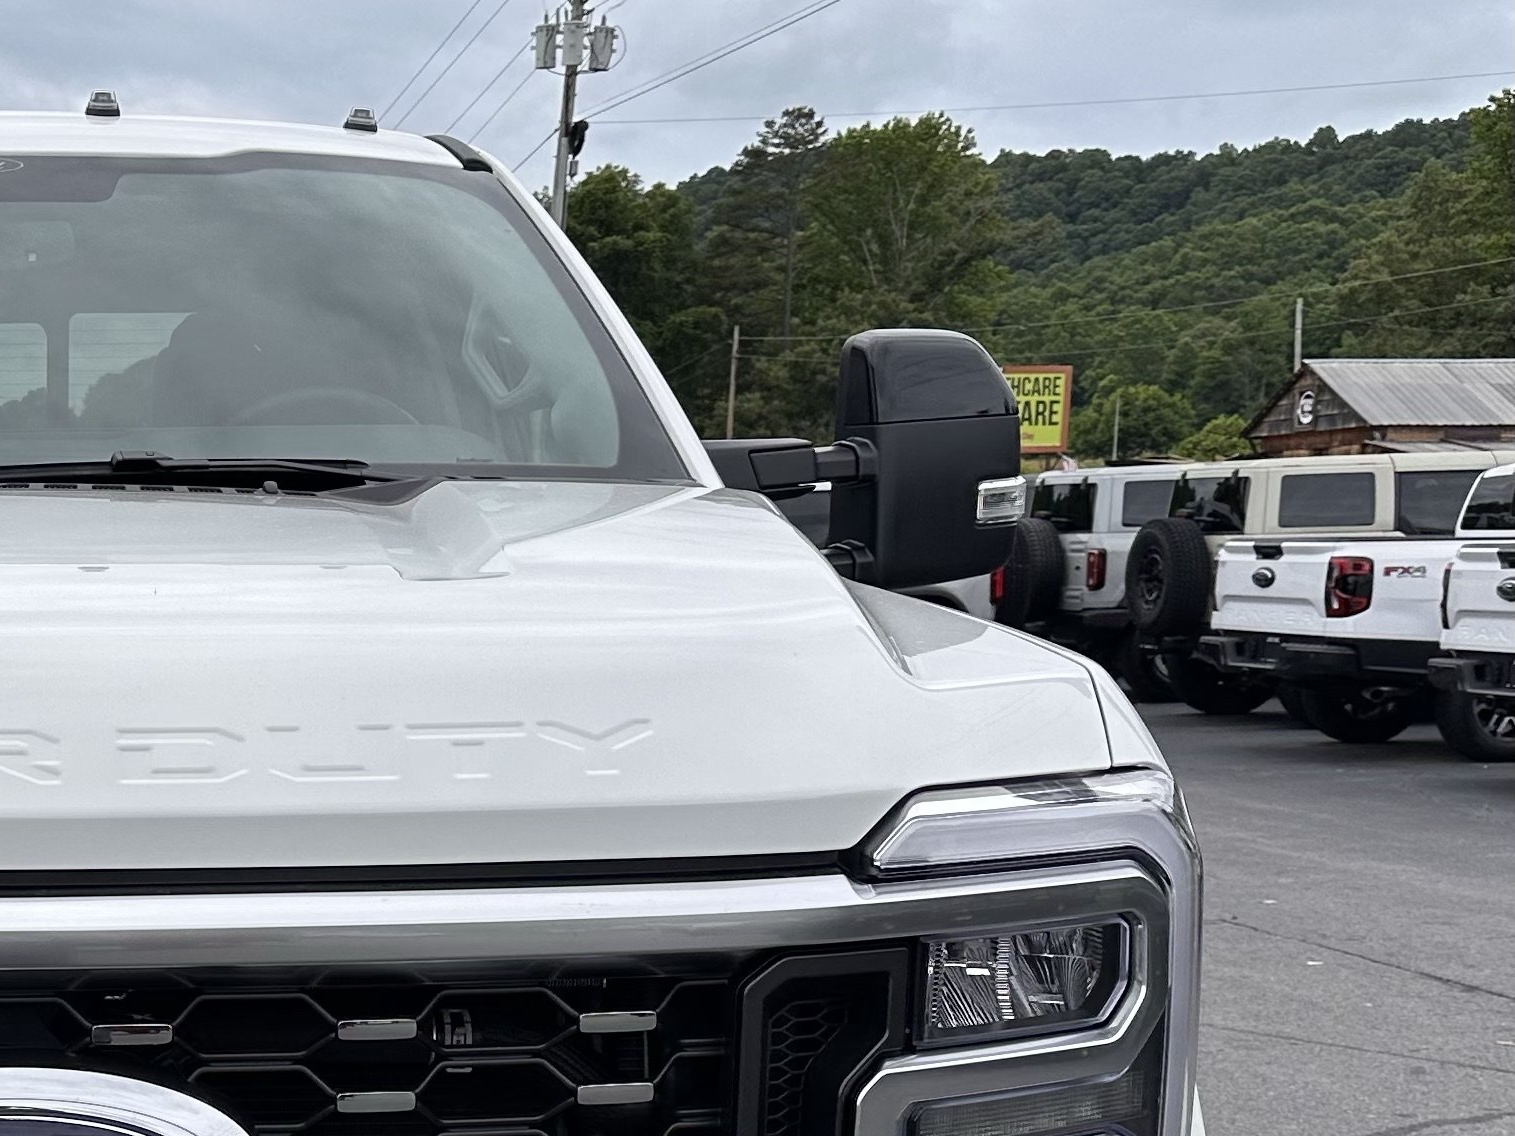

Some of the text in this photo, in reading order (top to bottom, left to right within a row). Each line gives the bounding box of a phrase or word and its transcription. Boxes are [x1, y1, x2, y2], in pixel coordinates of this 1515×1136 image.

[1017, 400, 1061, 426] ARE
[1383, 566, 1427, 579] FX4
[114, 719, 654, 785] DUTY
